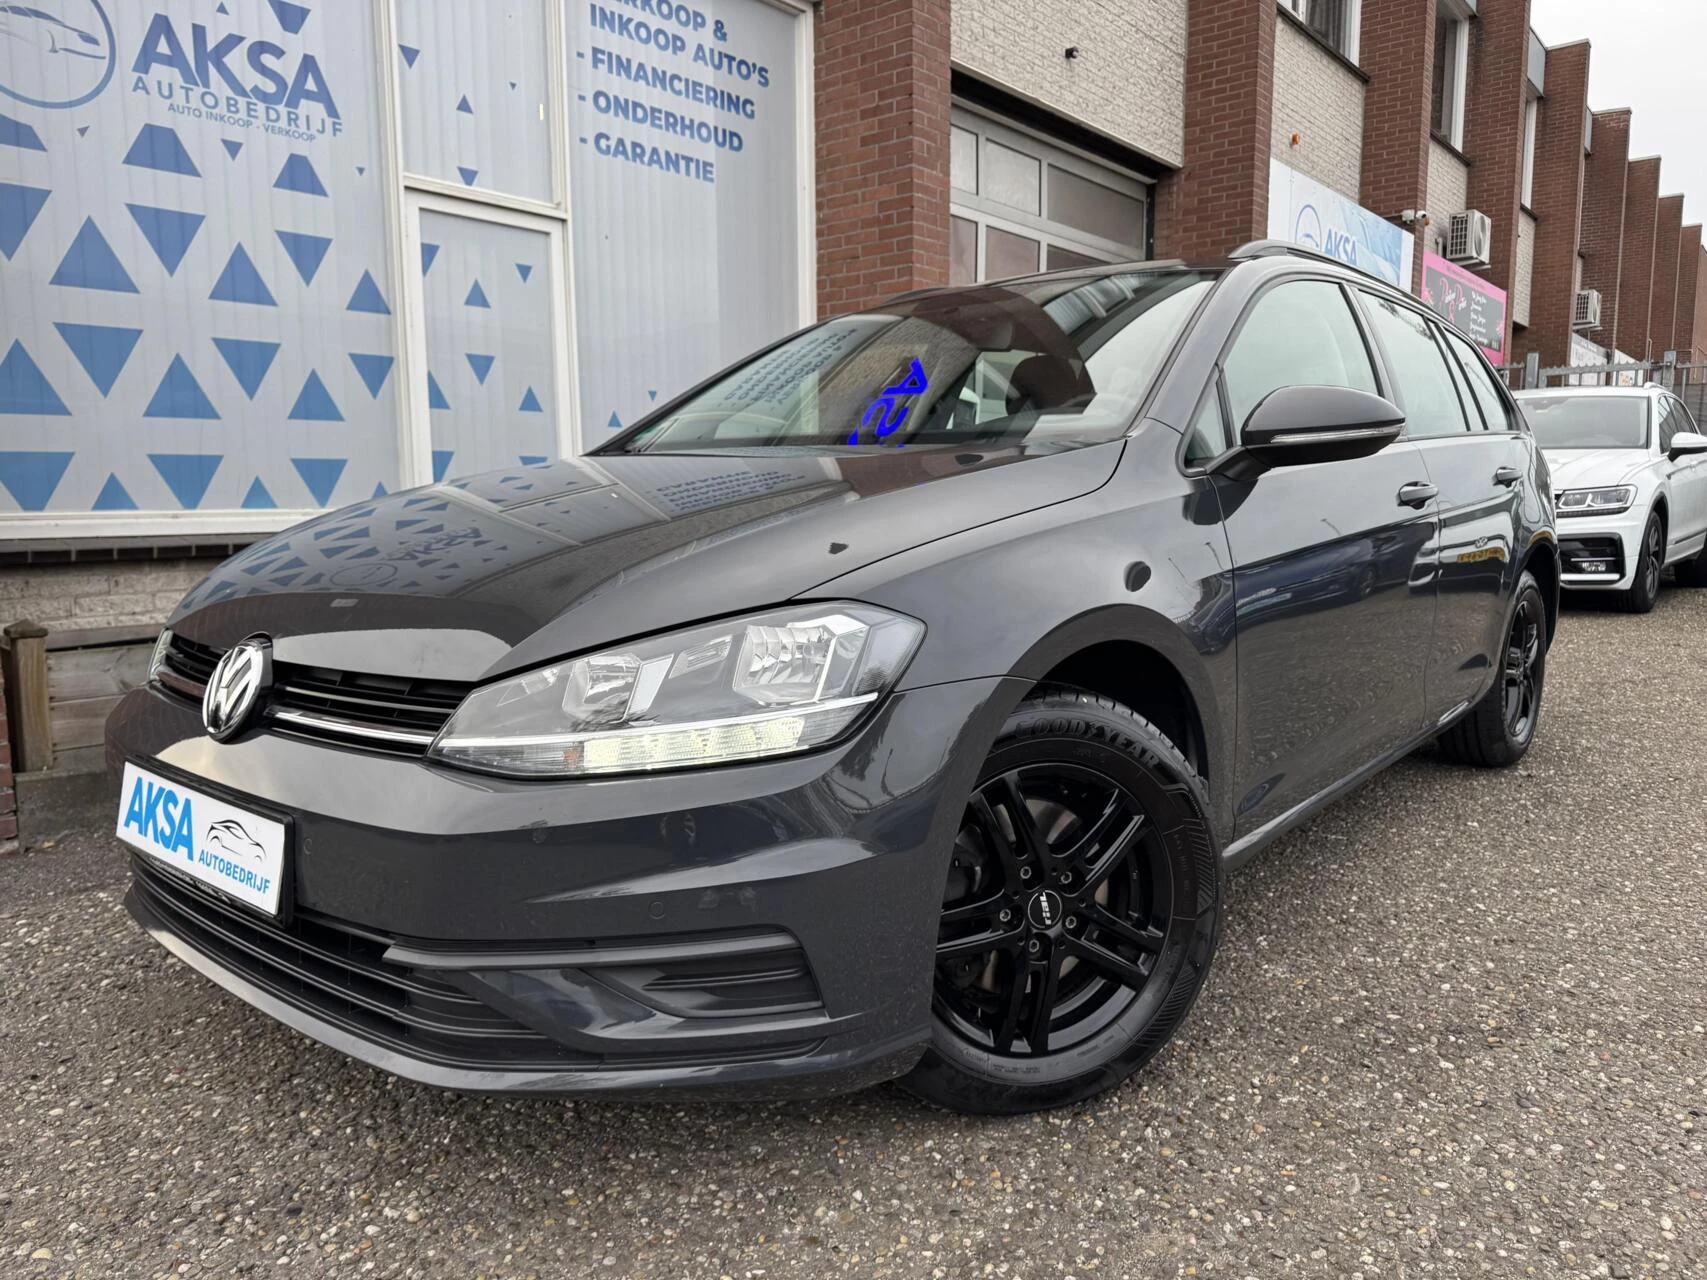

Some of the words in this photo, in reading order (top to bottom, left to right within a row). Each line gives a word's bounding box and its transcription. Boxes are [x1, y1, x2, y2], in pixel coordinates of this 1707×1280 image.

[590, 3, 686, 55] INKOOP
[692, 43, 770, 88] AUTO'S
[713, 20, 728, 42] &
[131, 12, 341, 120] AKSA
[591, 46, 756, 120] FINANCIERING
[131, 75, 343, 138] AUTOBEDRIJF
[167, 102, 203, 119] AUTO
[204, 110, 254, 130] INKOOP
[262, 123, 317, 143] VERKOOP
[592, 90, 744, 152] ONDERHOUD
[594, 132, 715, 183] GARANTIE
[1324, 228, 1358, 266] AKSA
[1014, 717, 1161, 769] GOODYEAR
[124, 776, 194, 861] AKSA
[198, 849, 271, 894] AUTOBEDRIJF
